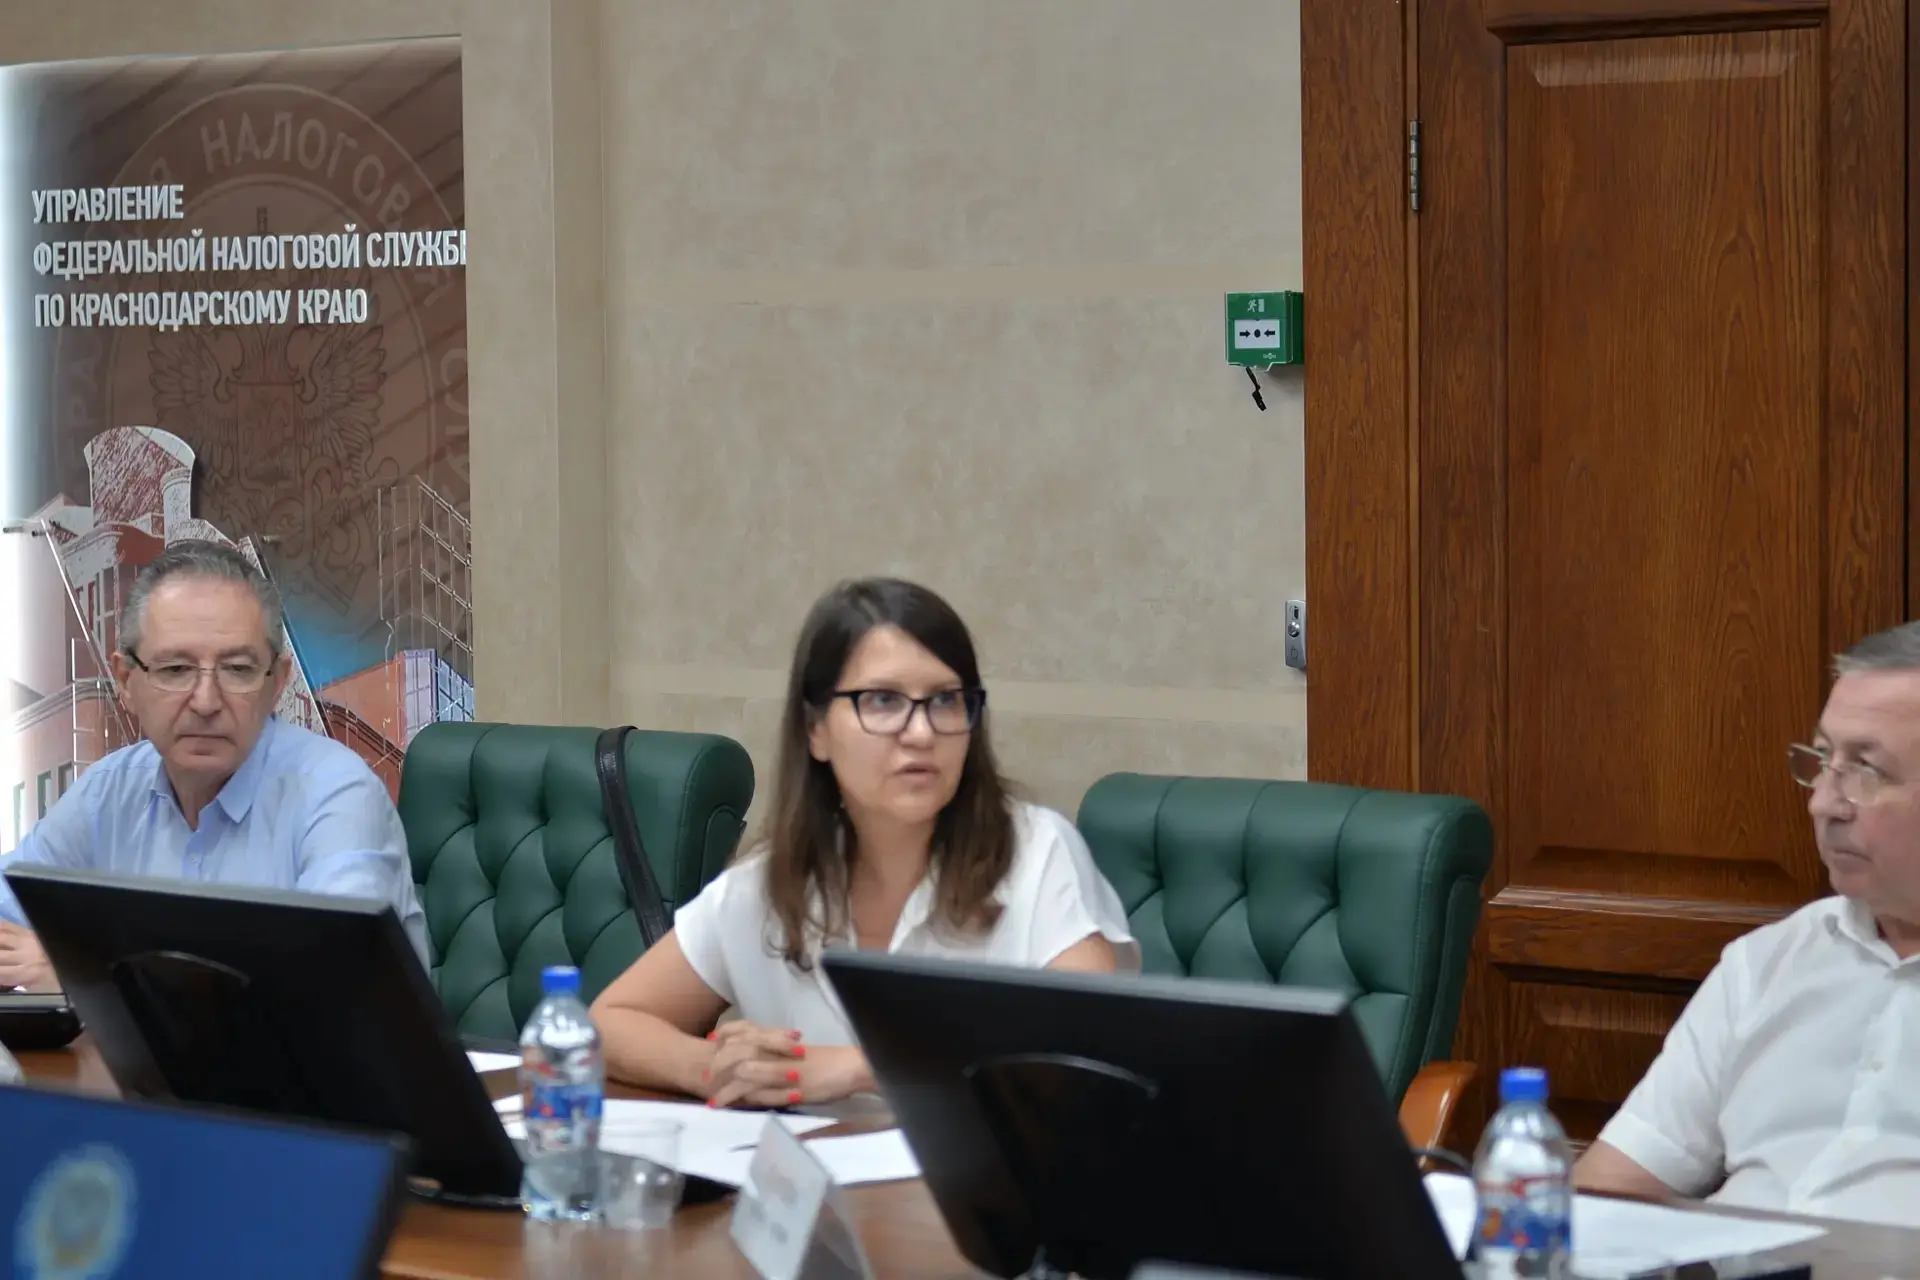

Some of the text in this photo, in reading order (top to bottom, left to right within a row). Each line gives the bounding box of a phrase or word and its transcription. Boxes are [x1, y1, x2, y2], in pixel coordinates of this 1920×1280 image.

[31, 184, 184, 224] УПРАВЛЕНИЕ
[33, 228, 206, 281] ФЕДЕРАЛЬНОЙ
[212, 223, 360, 271] НАЛОГОВОЙ
[34, 288, 368, 332] ПО КРАСНОДАРСКОМУ КРАЮ
